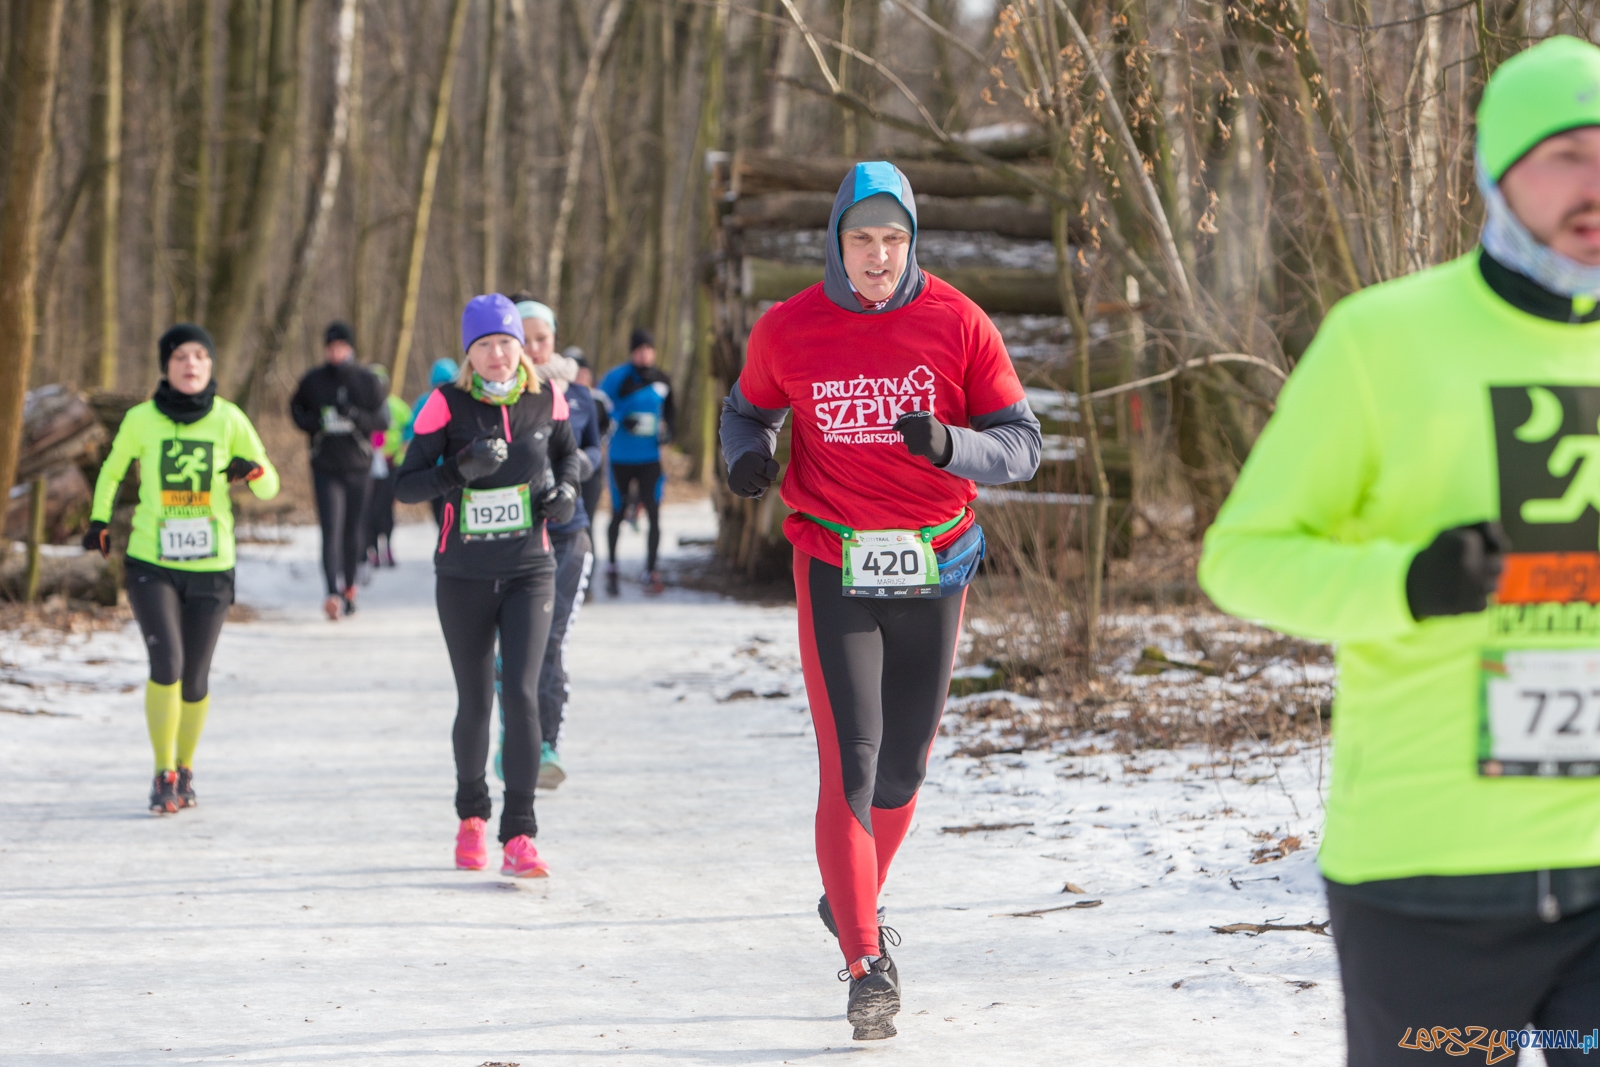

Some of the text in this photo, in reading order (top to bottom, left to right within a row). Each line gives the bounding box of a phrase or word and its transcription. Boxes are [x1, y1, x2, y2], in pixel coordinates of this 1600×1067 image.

[811, 374, 915, 400] DRUŻYNA
[471, 503, 520, 525] 1920
[167, 530, 208, 549] 1143
[862, 549, 919, 576] 420
[876, 578, 906, 586] MARIUSZ
[1530, 552, 1600, 601] nig
[1489, 602, 1600, 632] runn
